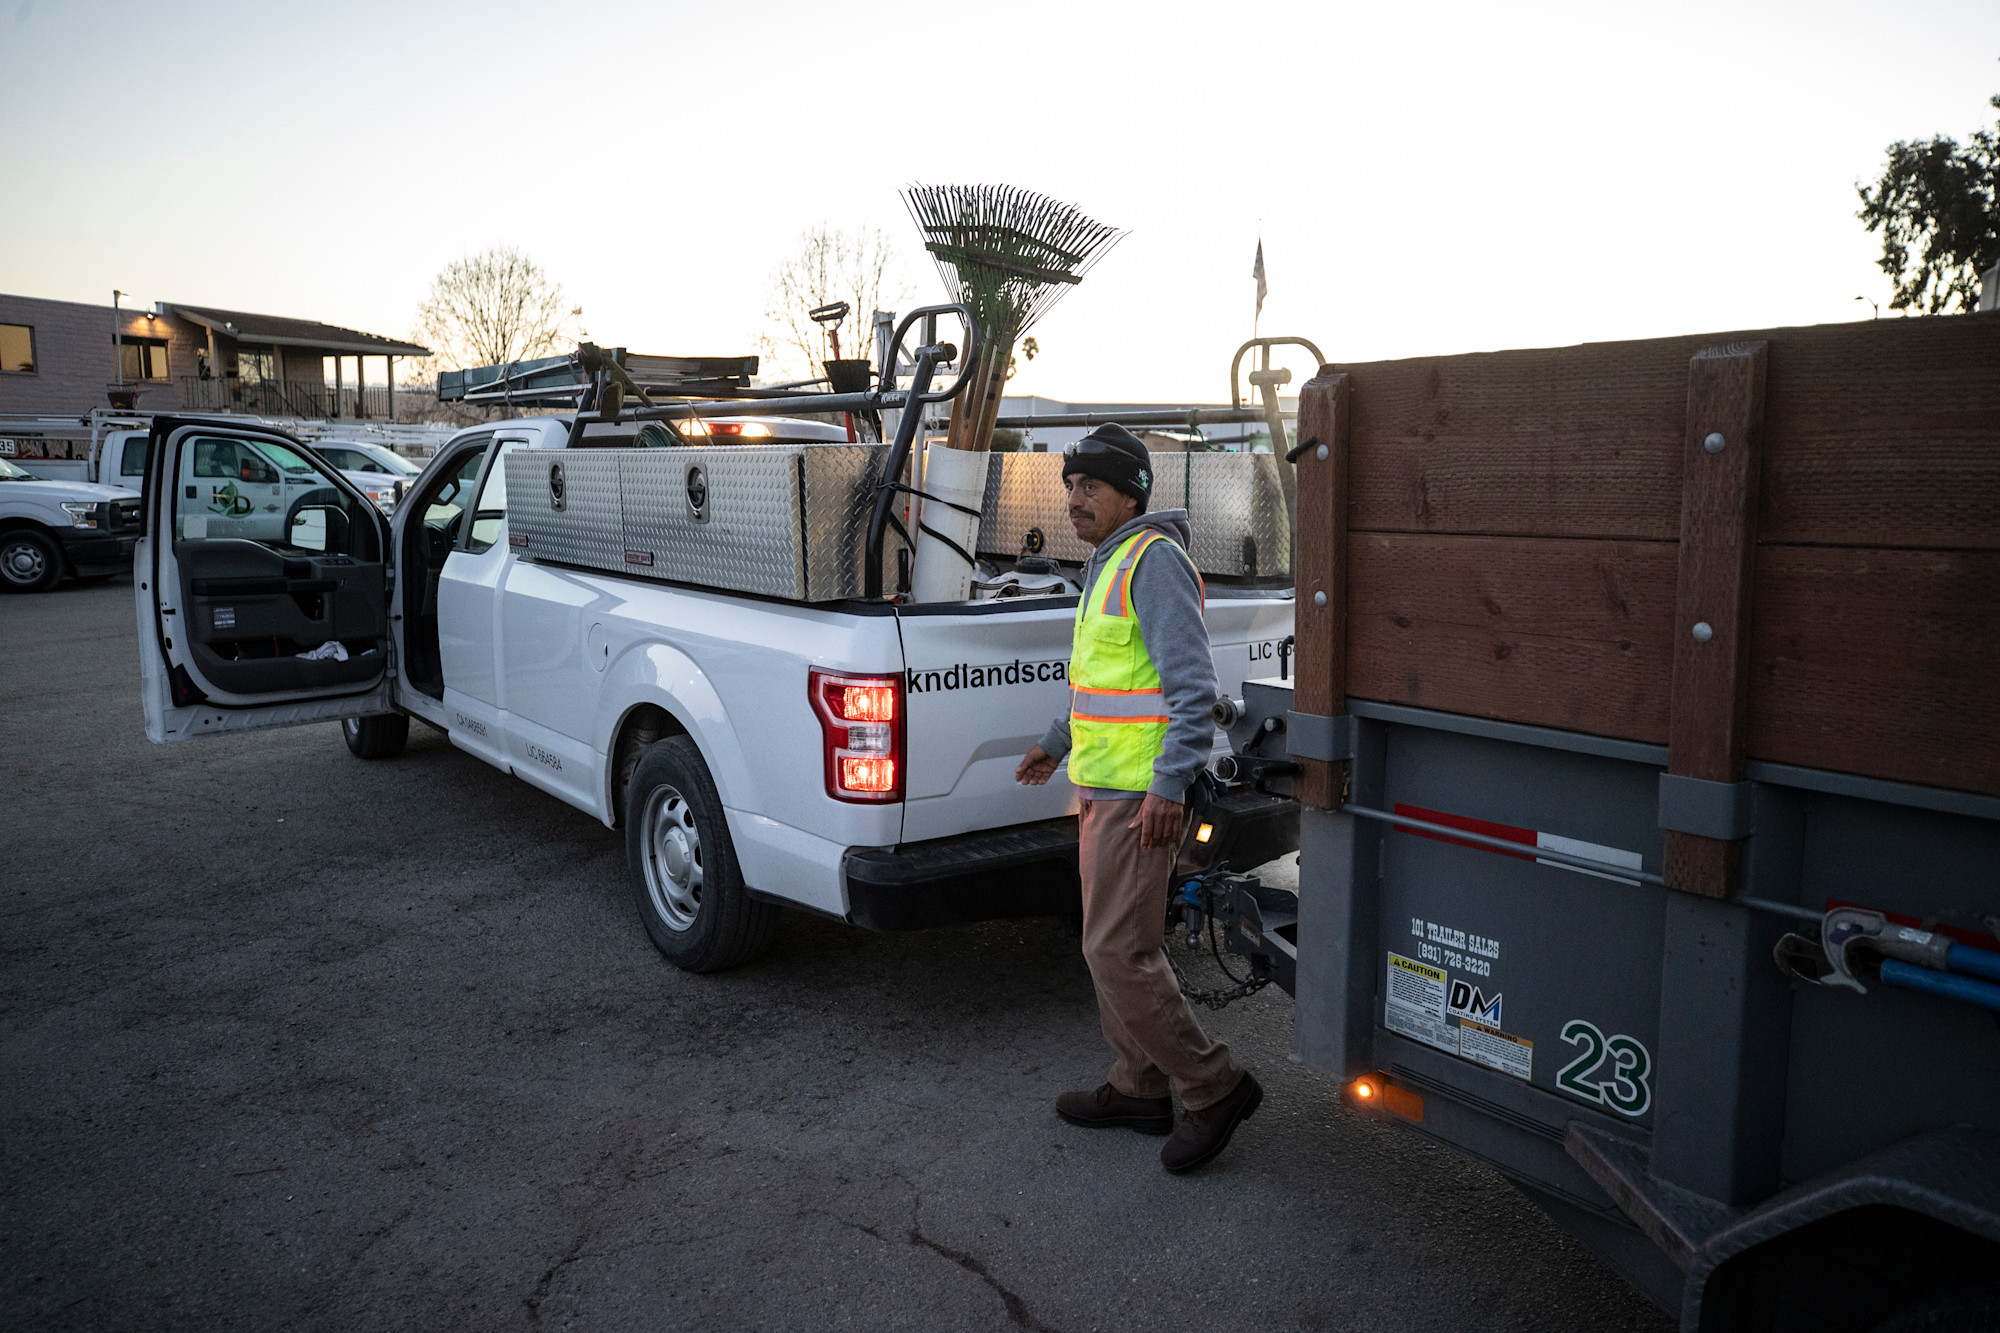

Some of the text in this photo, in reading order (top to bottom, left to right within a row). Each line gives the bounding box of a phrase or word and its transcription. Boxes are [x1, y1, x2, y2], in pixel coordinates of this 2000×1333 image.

[1249, 642, 1272, 661] LIC
[908, 659, 1071, 694] kndlandsca
[526, 742, 538, 760] LIC
[1411, 917, 1500, 959] 101 TRAILER SALES
[1401, 960, 1440, 980] CAUTION
[1417, 941, 1491, 977] (831) 726-3220
[1450, 981, 1501, 1022] DM
[1448, 1007, 1499, 1028] COATING SYSTEM
[1484, 1026, 1518, 1043] WARNING
[1556, 1019, 1652, 1117] 23
